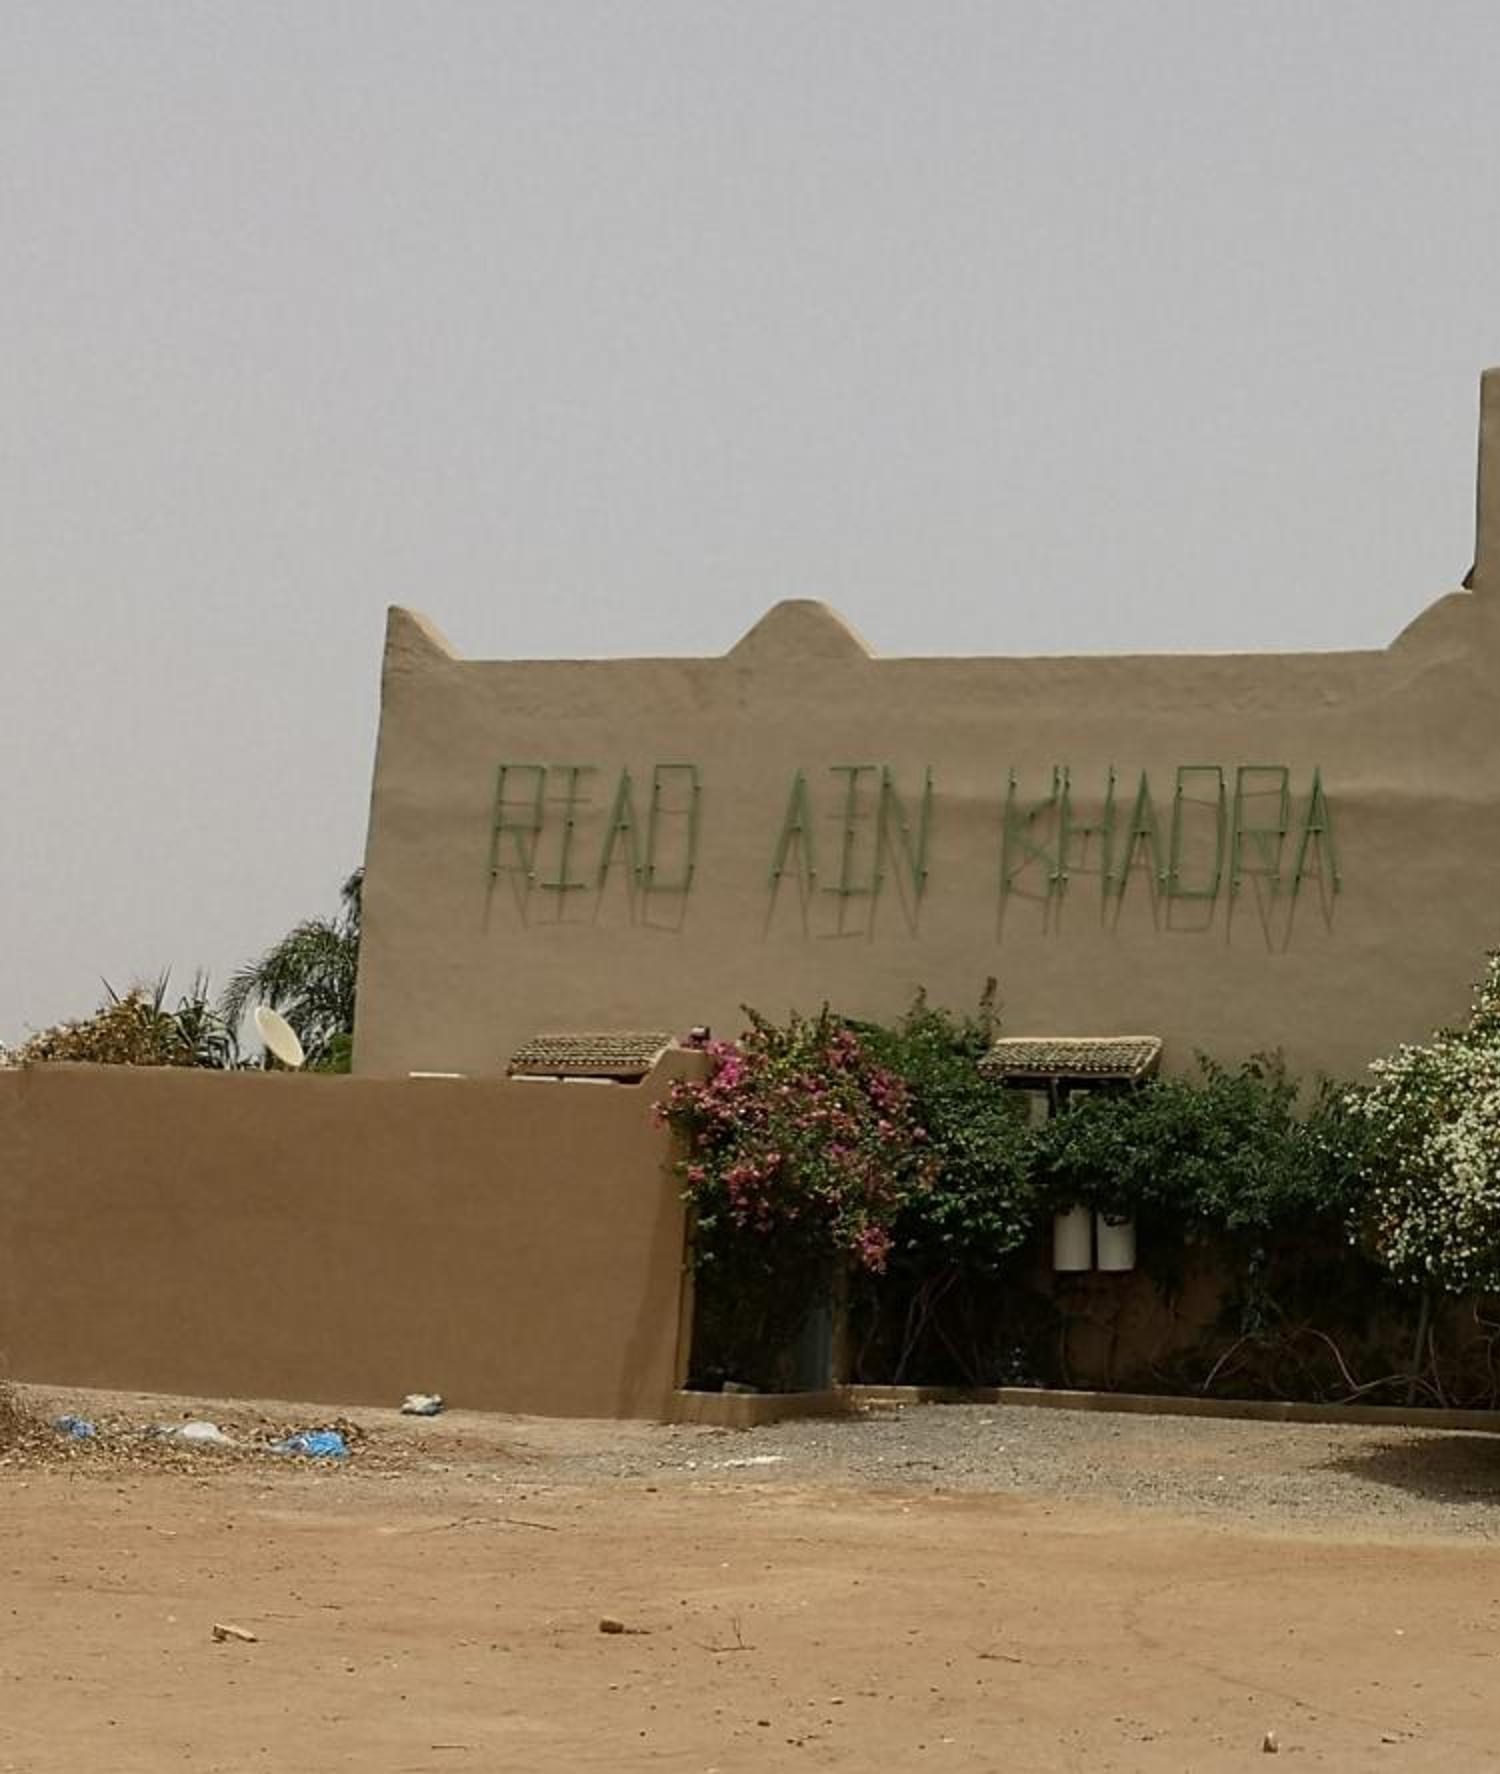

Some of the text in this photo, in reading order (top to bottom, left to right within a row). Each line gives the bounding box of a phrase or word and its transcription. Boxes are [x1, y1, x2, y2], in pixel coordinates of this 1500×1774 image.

[486, 764, 1342, 899] RIAD AIN KHADRA
